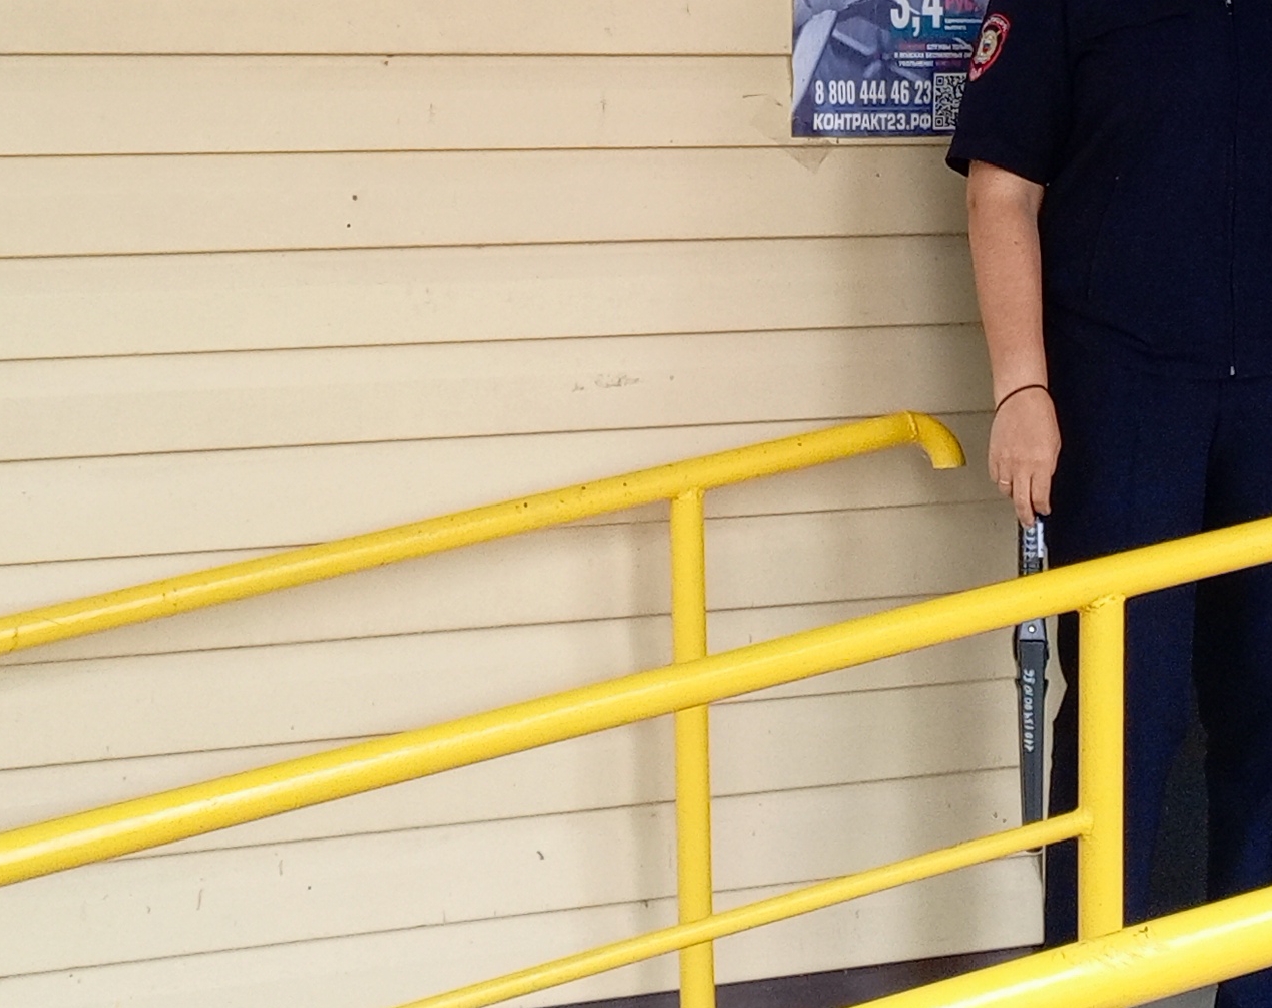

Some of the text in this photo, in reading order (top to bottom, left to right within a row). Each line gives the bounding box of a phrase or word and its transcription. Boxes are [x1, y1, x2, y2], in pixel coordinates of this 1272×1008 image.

[815, 80, 932, 105] 8 800 444 46 23
[813, 113, 932, 131] КОНТРАКТ23.РФ
